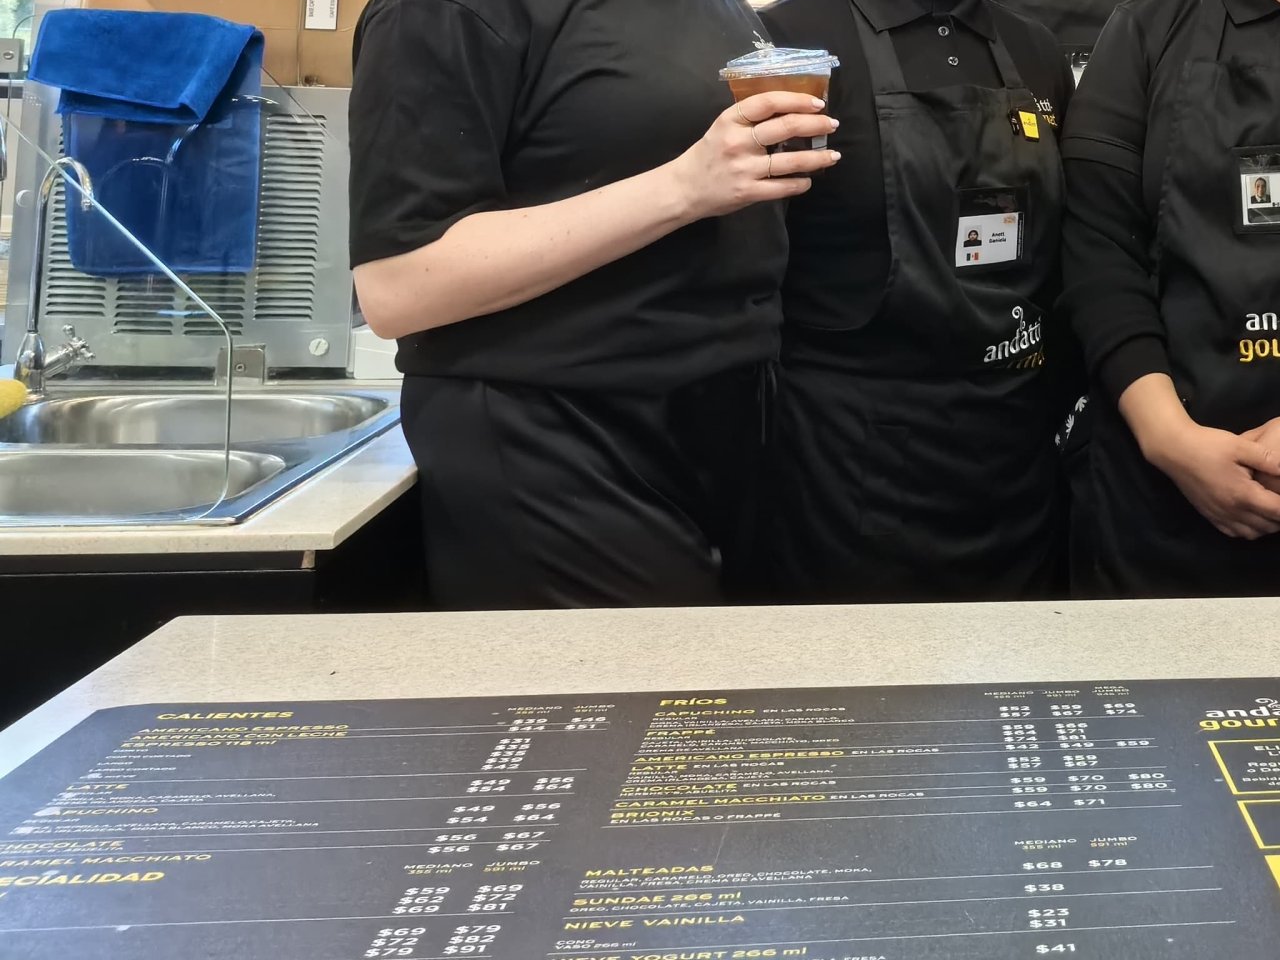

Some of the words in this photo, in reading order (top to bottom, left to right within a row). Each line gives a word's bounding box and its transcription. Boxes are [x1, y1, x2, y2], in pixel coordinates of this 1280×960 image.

[659, 697, 728, 707] FRÍOS
[157, 711, 295, 720] CALIENTES
[655, 709, 756, 717] CAPUCHINO
[252, 724, 349, 732] ESPRESSO
[615, 798, 710, 809] CARAMEL
[713, 794, 826, 806] MACCHIATO
[1022, 861, 1063, 870] $68
[1087, 858, 1128, 868] $78
[585, 864, 713, 877] MALTEADAS
[0, 870, 165, 887] ECIALIDAD
[564, 919, 634, 930] NIEVE
[643, 914, 745, 927] VAINILLA
